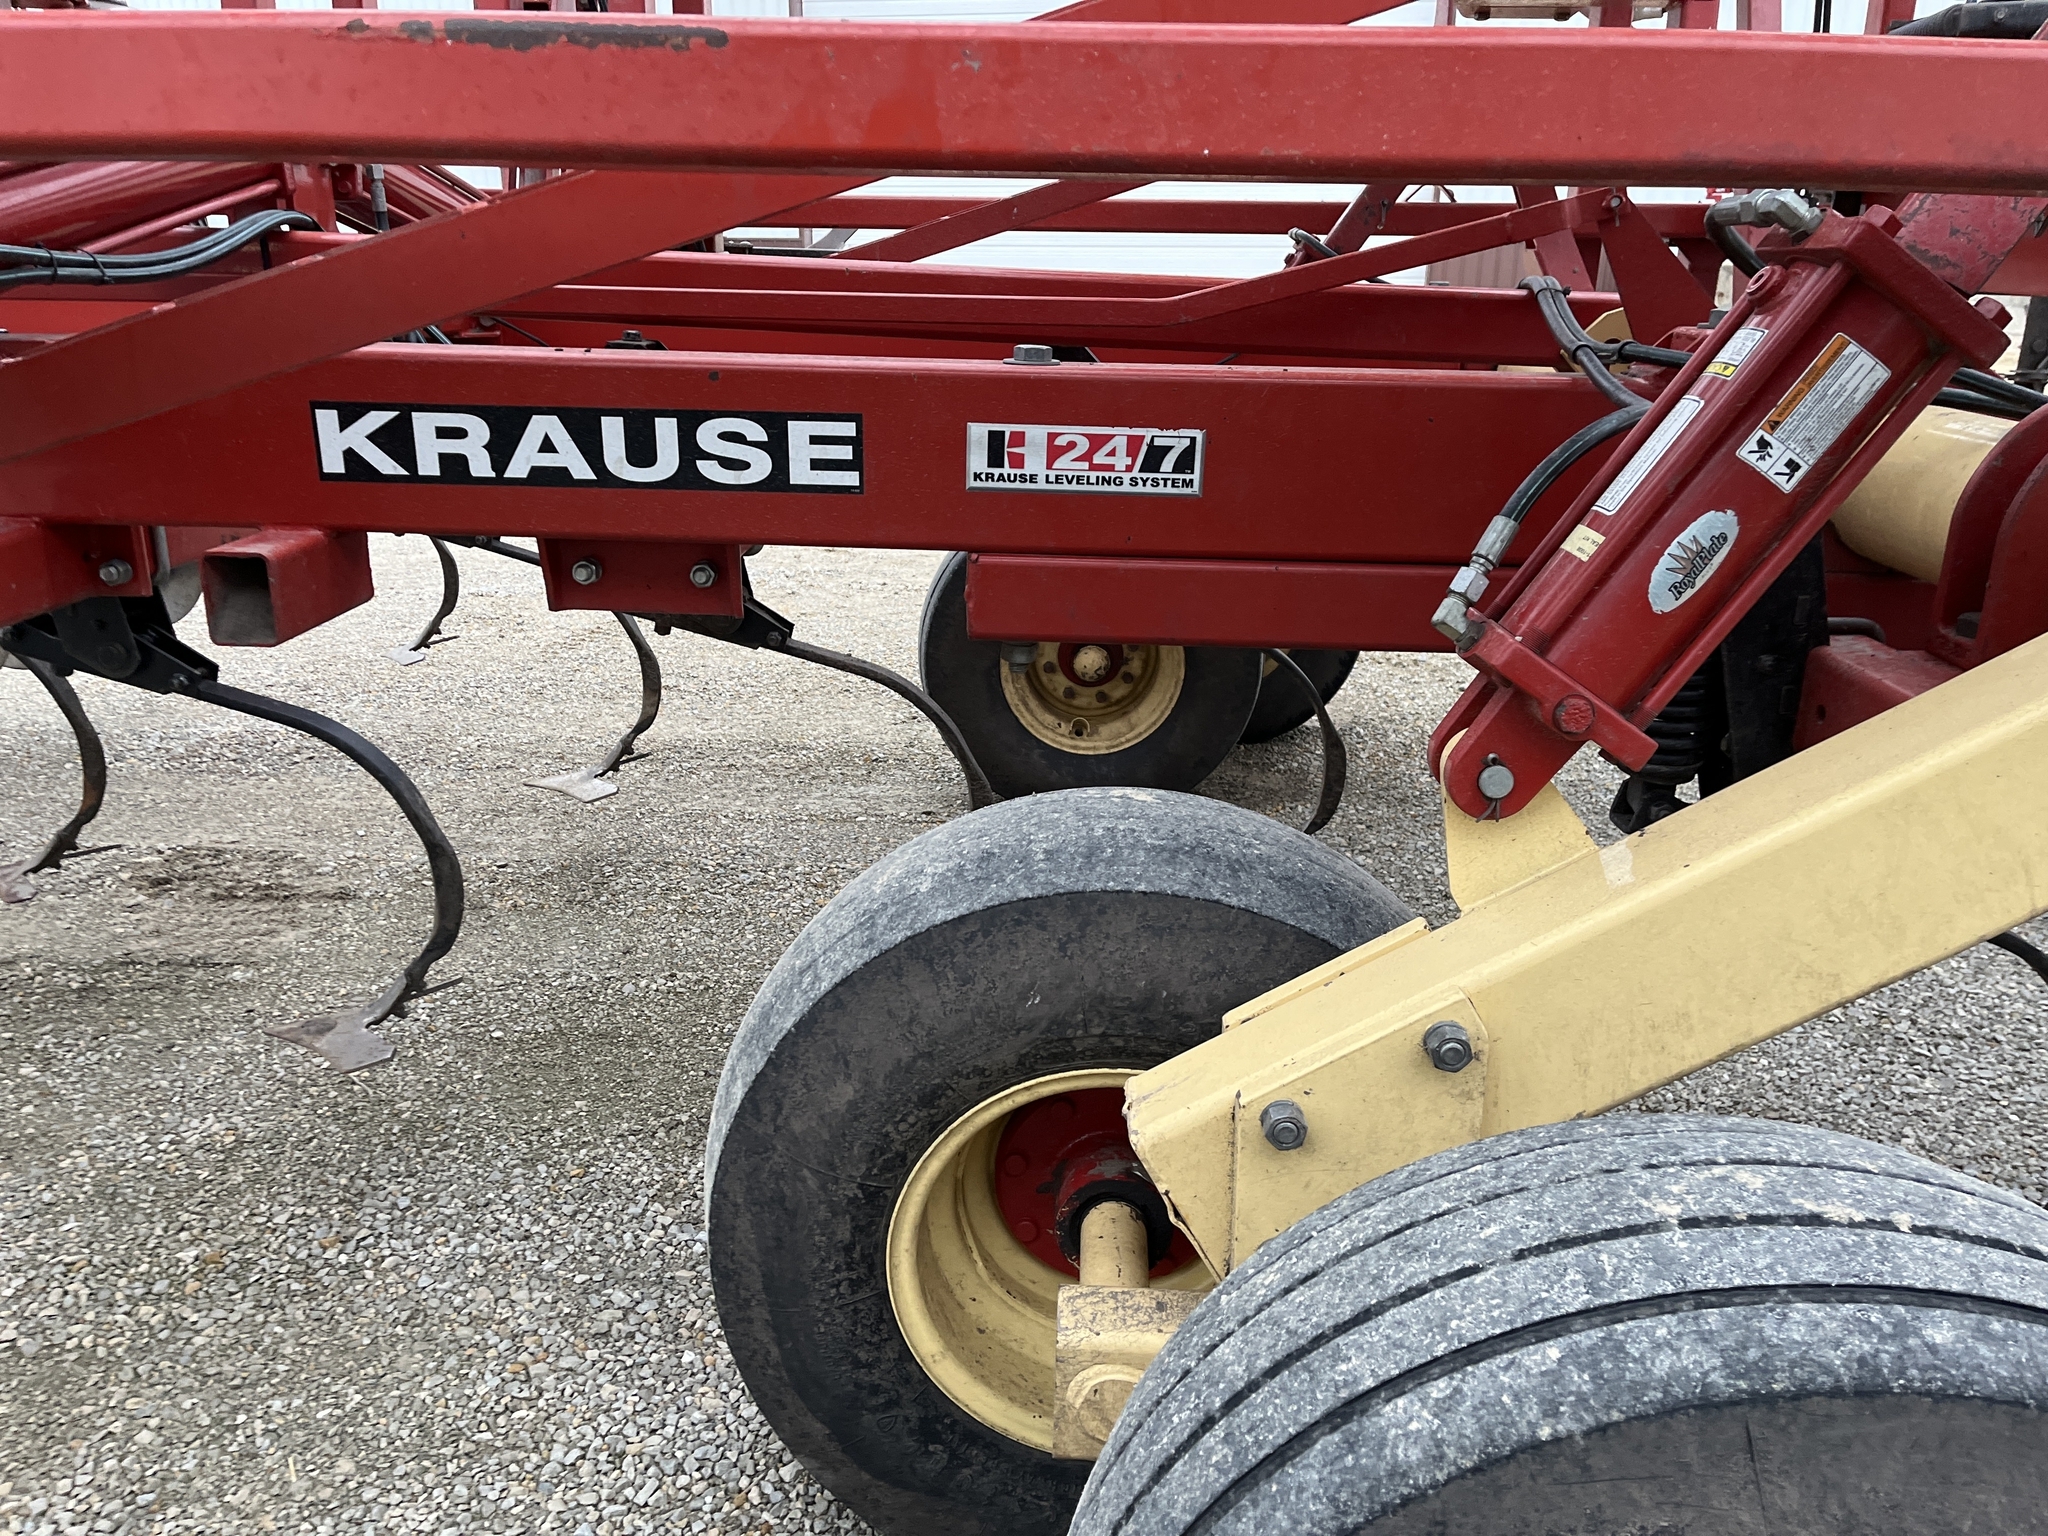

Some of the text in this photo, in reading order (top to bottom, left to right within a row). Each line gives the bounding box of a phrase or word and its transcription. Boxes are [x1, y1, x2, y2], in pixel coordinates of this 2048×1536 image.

[1776, 388, 1805, 417] WARNING
[314, 409, 861, 486] KRAUSE
[973, 471, 1194, 490] KRAUSE LEVELING SYSTEM
[1668, 532, 1729, 601] RoyalPlate
